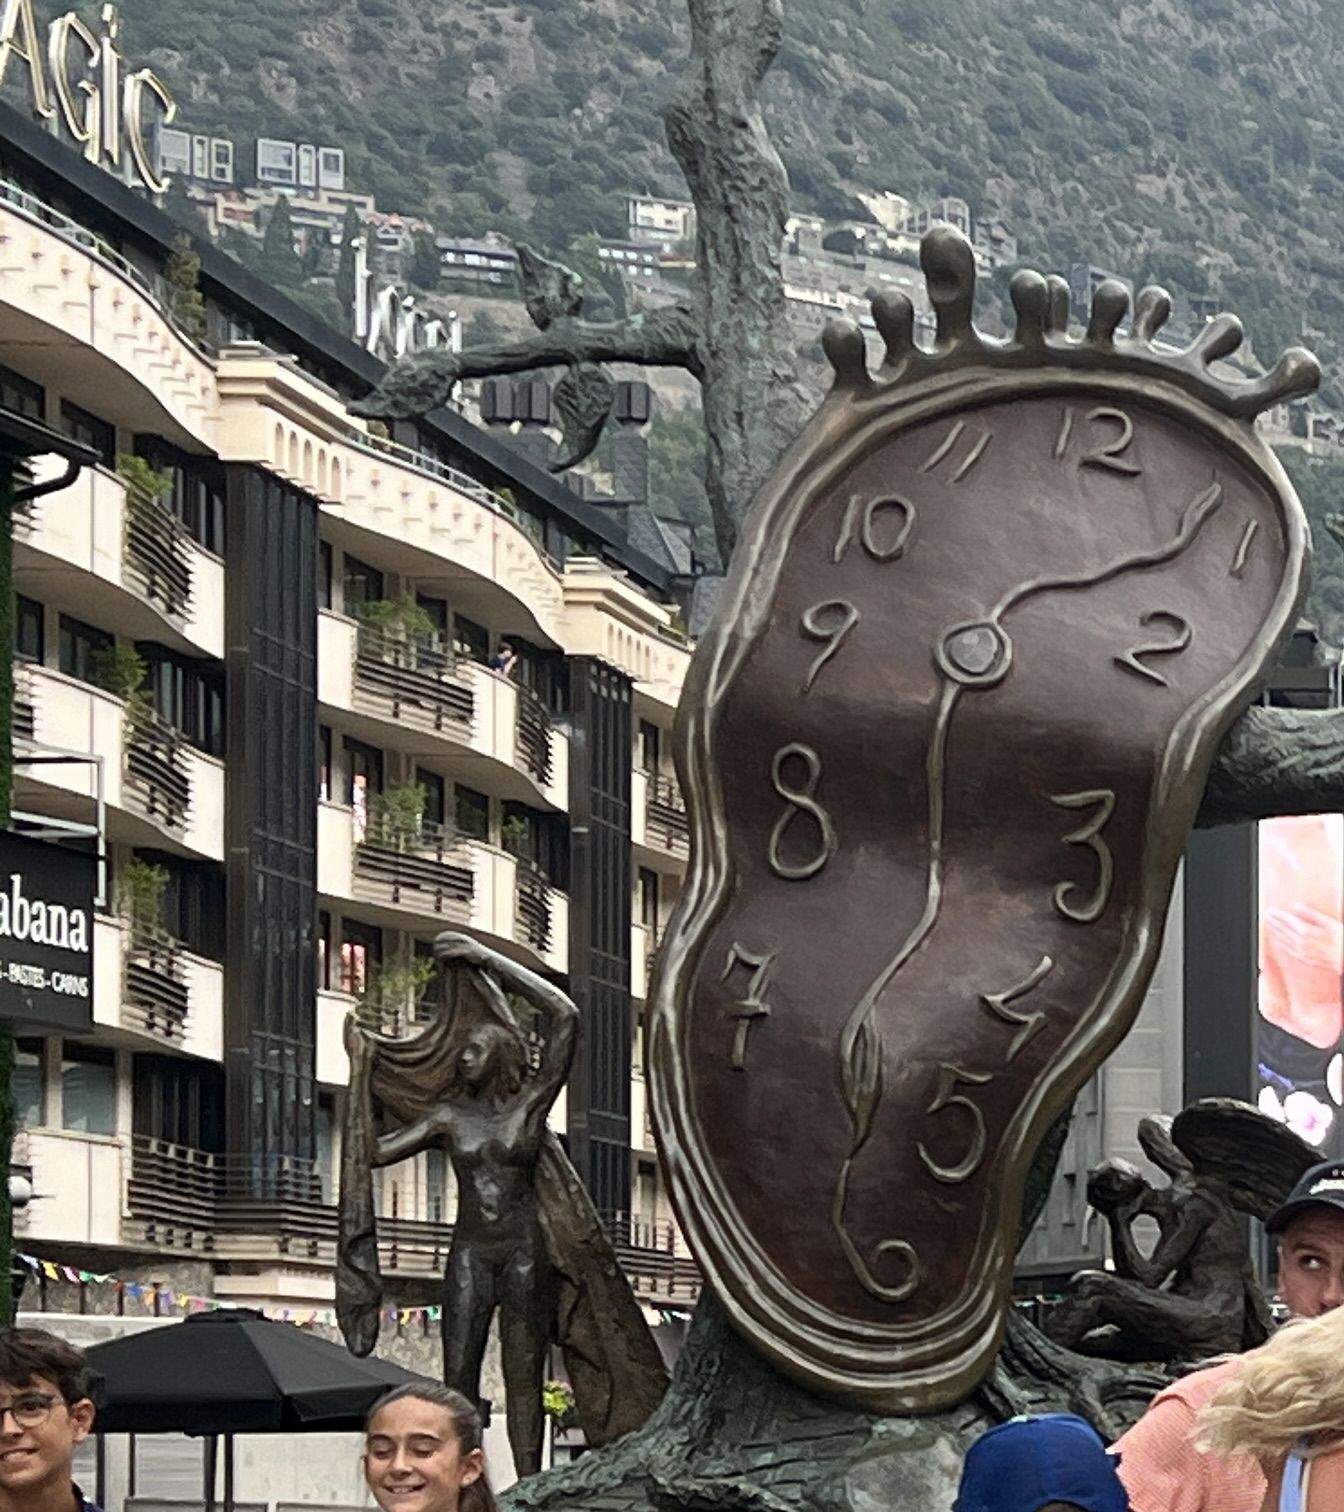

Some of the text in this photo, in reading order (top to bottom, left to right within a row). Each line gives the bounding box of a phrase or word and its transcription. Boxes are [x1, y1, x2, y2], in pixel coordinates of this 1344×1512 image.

[921, 420, 992, 485] 11
[1053, 407, 1142, 476] 12
[834, 494, 915, 563] 10
[1229, 518, 1258, 578] 1
[803, 600, 860, 692] 9
[1113, 610, 1193, 687] 2
[768, 742, 838, 880] 8
[1048, 789, 1115, 921] 3
[720, 941, 776, 1071] 7
[916, 1061, 994, 1183] 5
